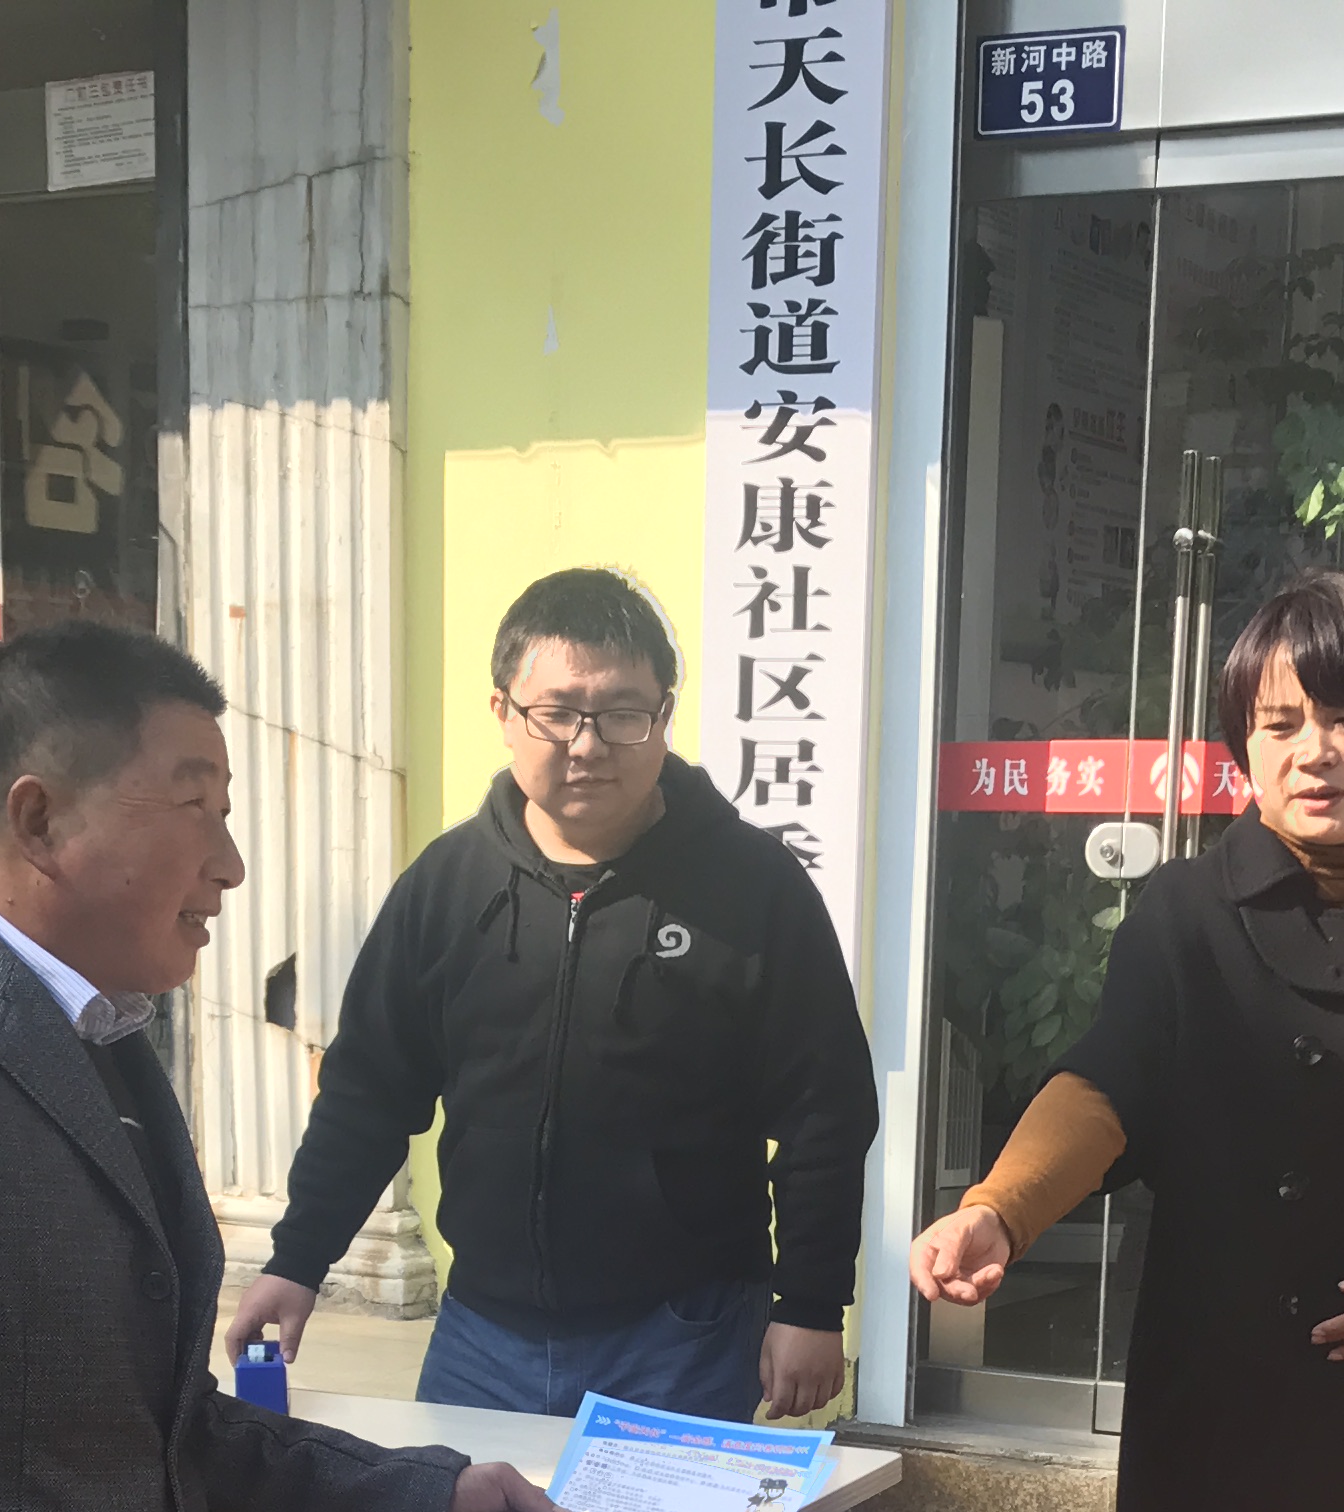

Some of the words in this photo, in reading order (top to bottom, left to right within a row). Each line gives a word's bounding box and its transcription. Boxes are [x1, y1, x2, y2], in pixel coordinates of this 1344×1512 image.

[991, 40, 1109, 76] 新河中路
[1019, 79, 1076, 123] 53
[730, 0, 849, 870] 天长街道安康社区居
[971, 755, 1105, 797] 为民务实
